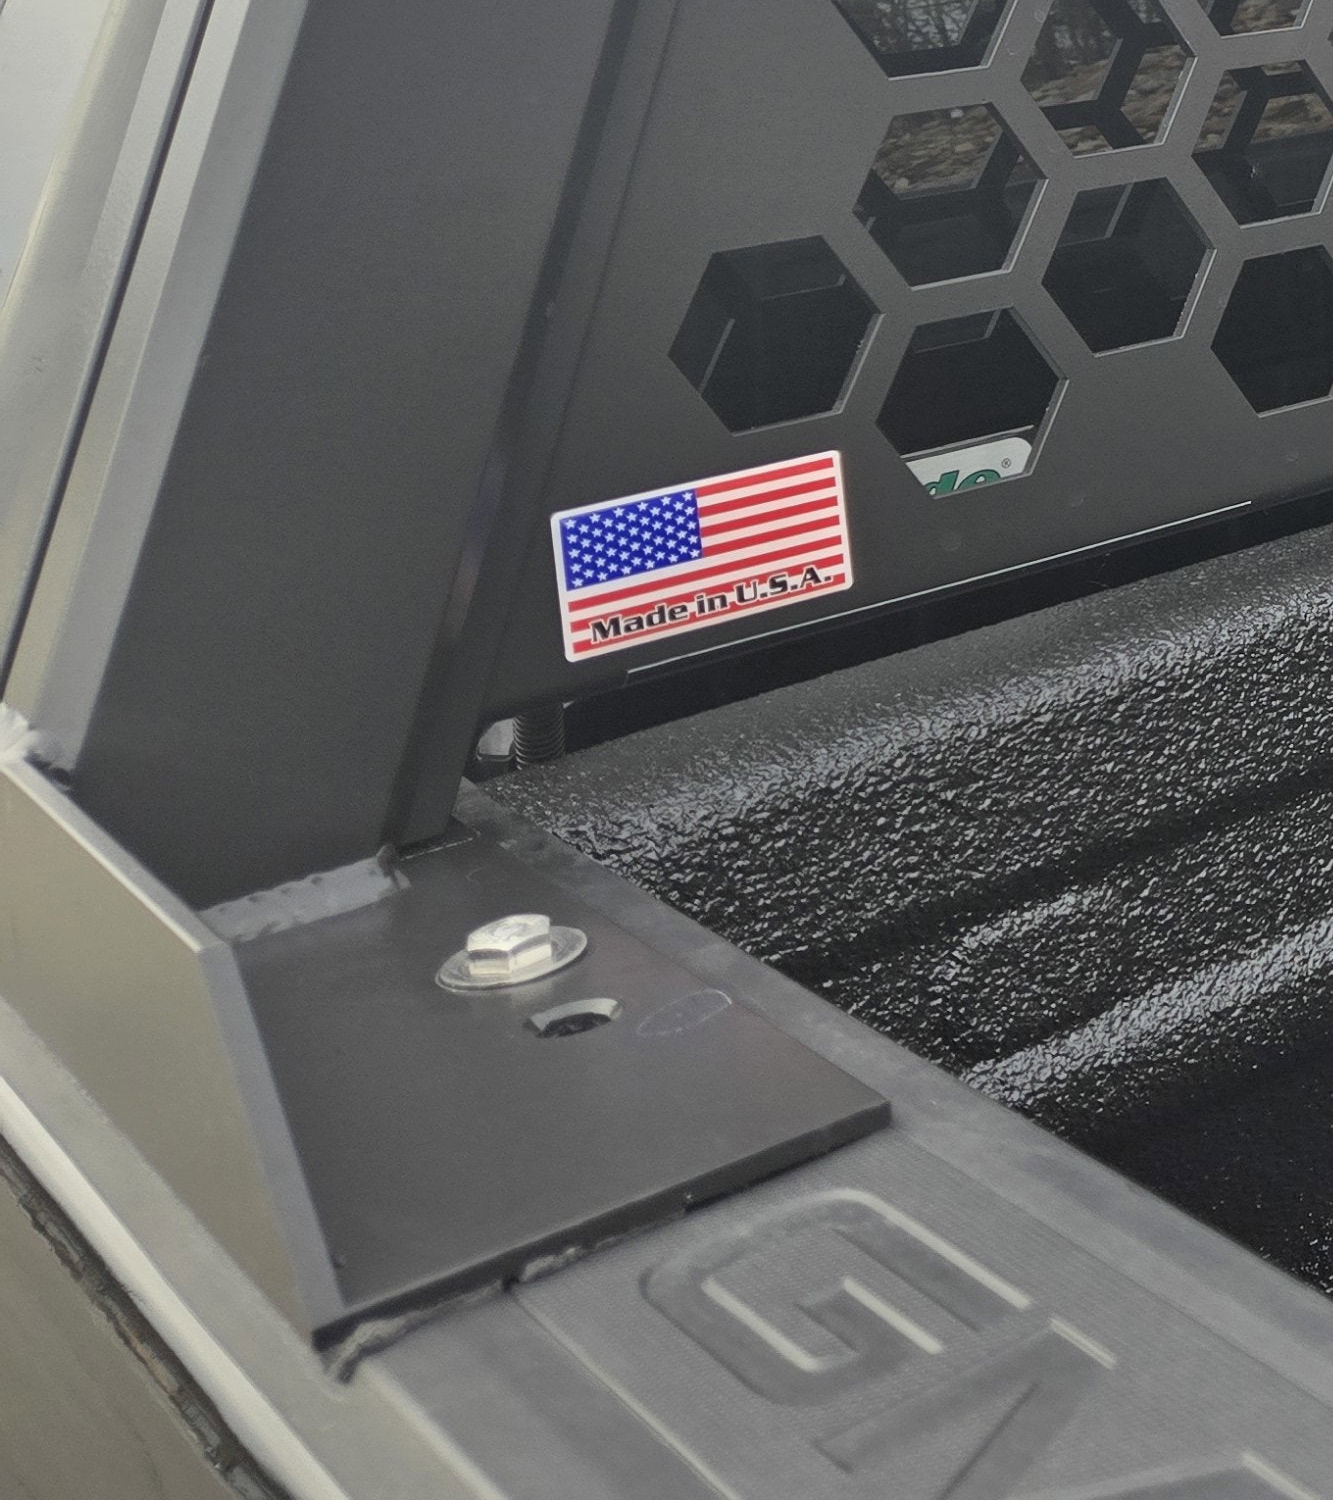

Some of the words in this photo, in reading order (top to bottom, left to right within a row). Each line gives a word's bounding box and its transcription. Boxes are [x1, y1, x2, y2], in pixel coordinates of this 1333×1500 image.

[590, 602, 689, 643] Made
[696, 591, 728, 615] in
[735, 566, 833, 604] U.S.A.
